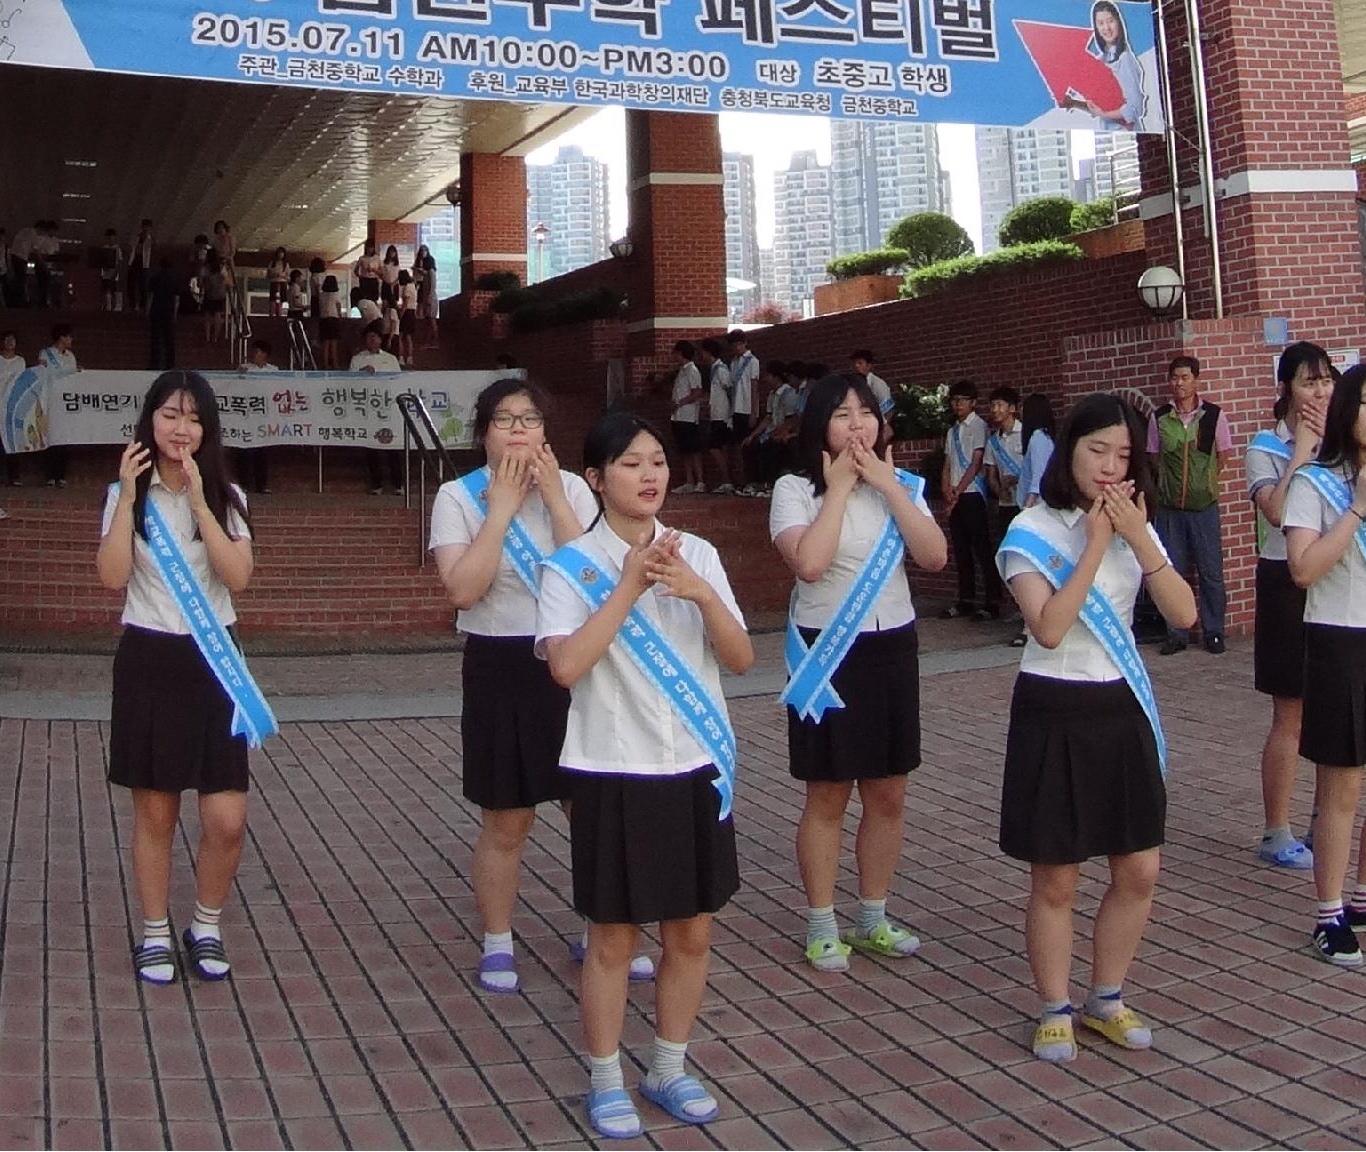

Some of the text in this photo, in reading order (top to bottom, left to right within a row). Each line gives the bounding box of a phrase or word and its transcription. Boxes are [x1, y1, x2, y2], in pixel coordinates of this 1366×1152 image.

[191, 17, 951, 94] 2015.07.11 AM10:00~PM3:00 대상 초중고 학생
[237, 55, 918, 118] 주관_금천중학교 수학과 후원_교육부 한국과학창의재단 충청북도교육청 금천중학교
[62, 392, 139, 414] 담배연기
[215, 395, 265, 417] 교폭력
[272, 389, 309, 416] 없는
[321, 388, 392, 419] 행복한
[219, 426, 252, 443] 조하는
[257, 424, 313, 439] SMART
[318, 427, 368, 442] 행복학교
